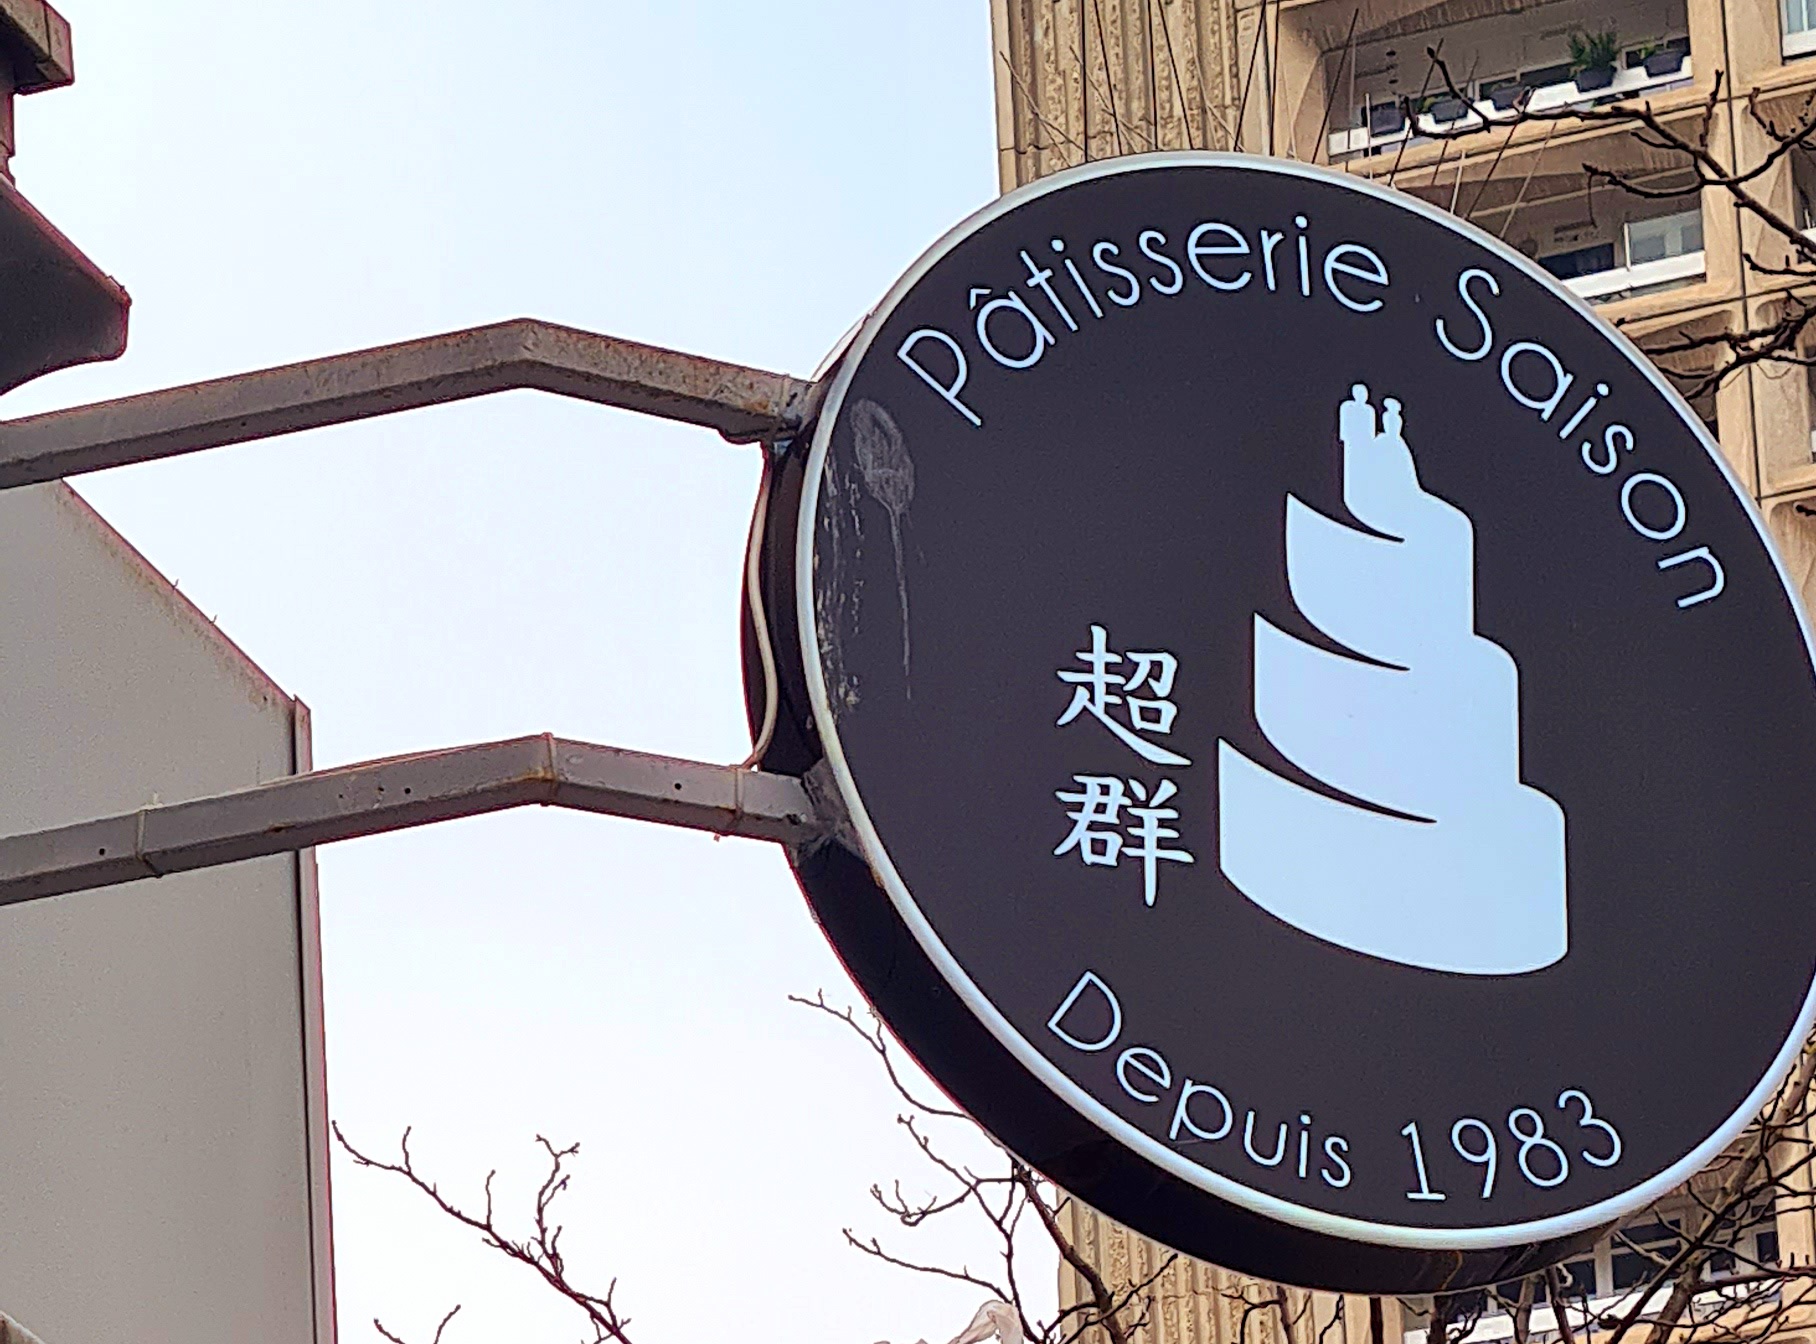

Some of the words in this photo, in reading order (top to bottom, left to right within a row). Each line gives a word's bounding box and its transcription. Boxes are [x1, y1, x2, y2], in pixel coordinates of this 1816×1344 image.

[897, 214, 1390, 427] Pâtisserie
[1435, 267, 1726, 609] Saison
[1054, 625, 1194, 906] 超群
[1045, 970, 1352, 1189] Depuis
[1400, 1088, 1623, 1202] 1983
